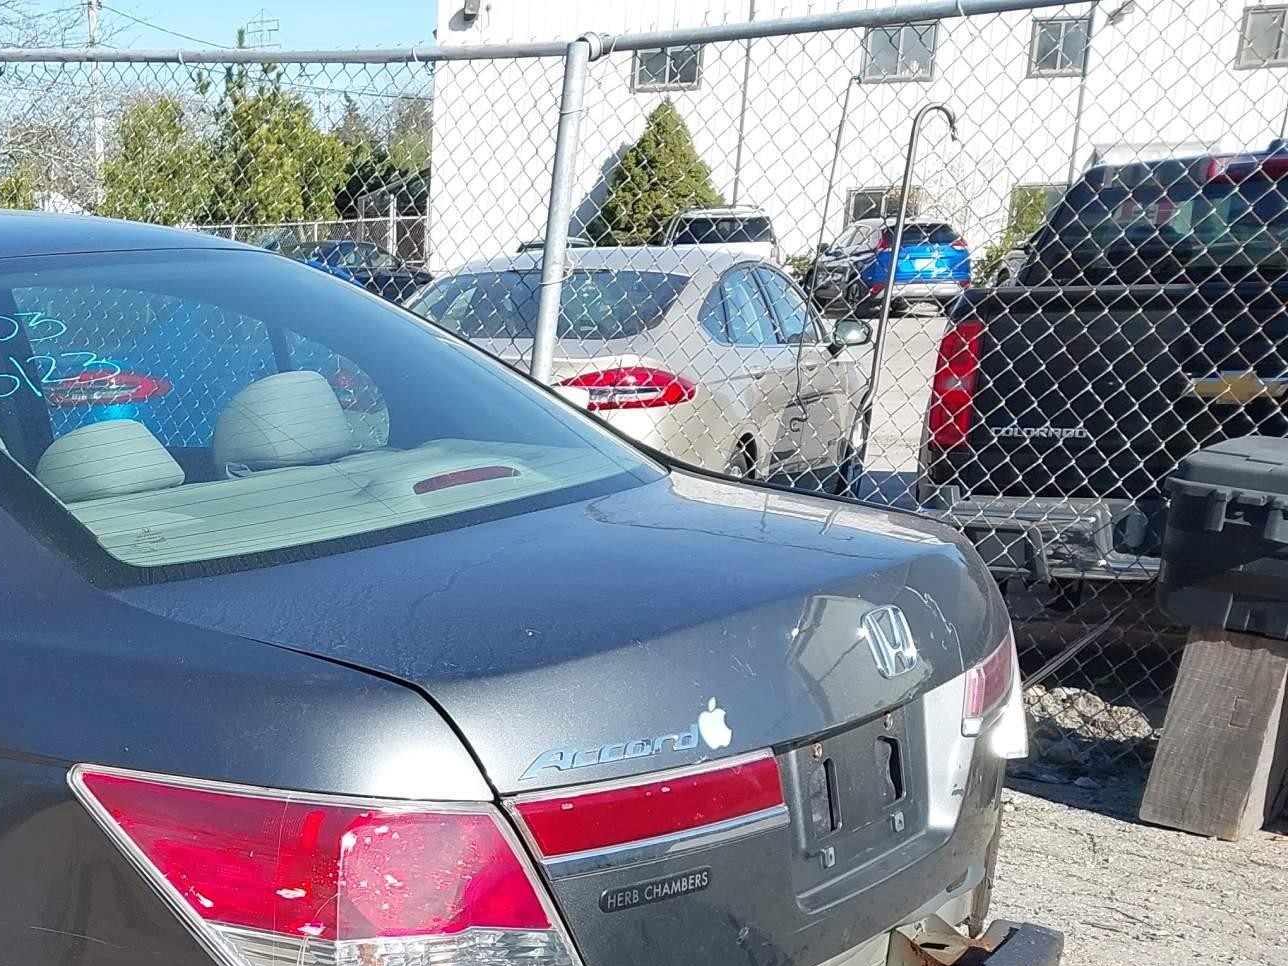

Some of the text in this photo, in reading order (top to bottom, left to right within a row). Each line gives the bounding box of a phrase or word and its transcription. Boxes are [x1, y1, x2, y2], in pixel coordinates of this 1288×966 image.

[991, 426, 1088, 439] COLORADO
[518, 724, 700, 781] Accord
[607, 871, 709, 909] HERB CHAMBERS
